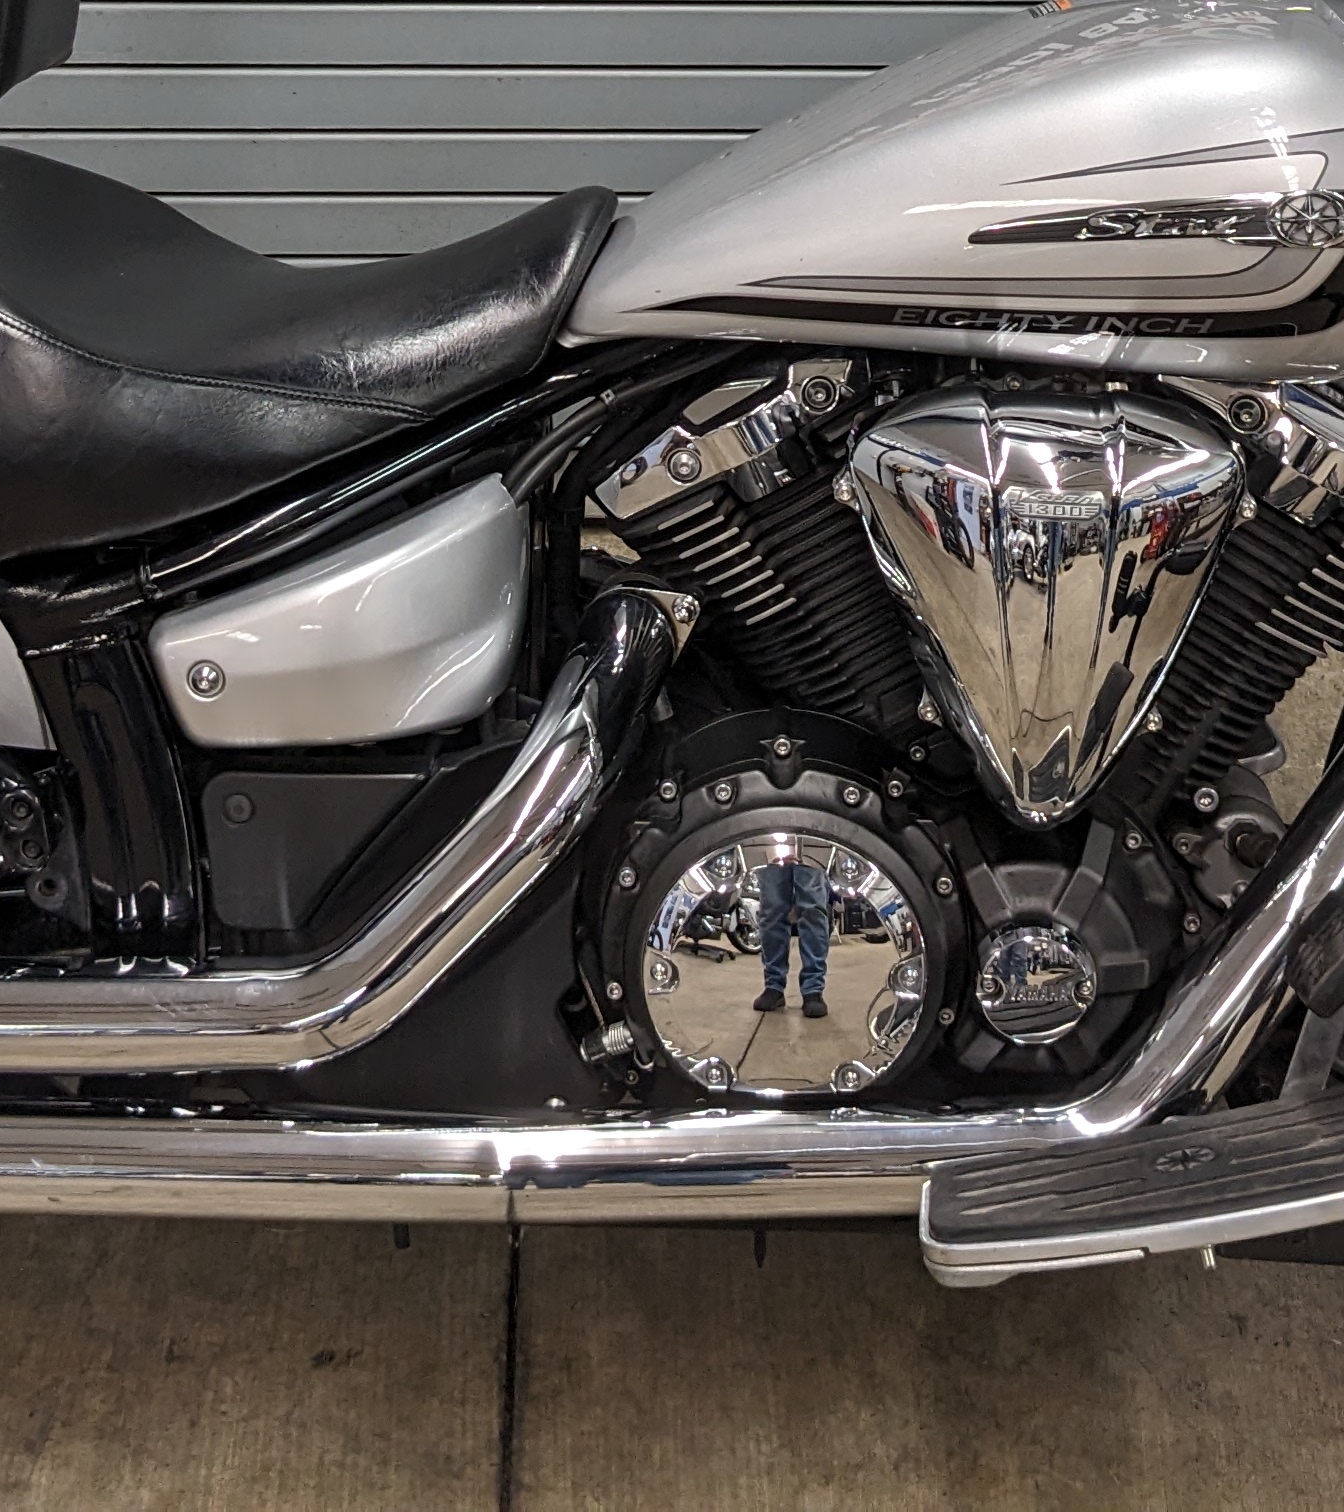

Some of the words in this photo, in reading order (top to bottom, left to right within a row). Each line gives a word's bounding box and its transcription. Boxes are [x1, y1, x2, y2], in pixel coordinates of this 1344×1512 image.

[891, 306, 1079, 331] EIGHTY
[1084, 314, 1215, 335] INCH
[1028, 503, 1084, 517] 1300
